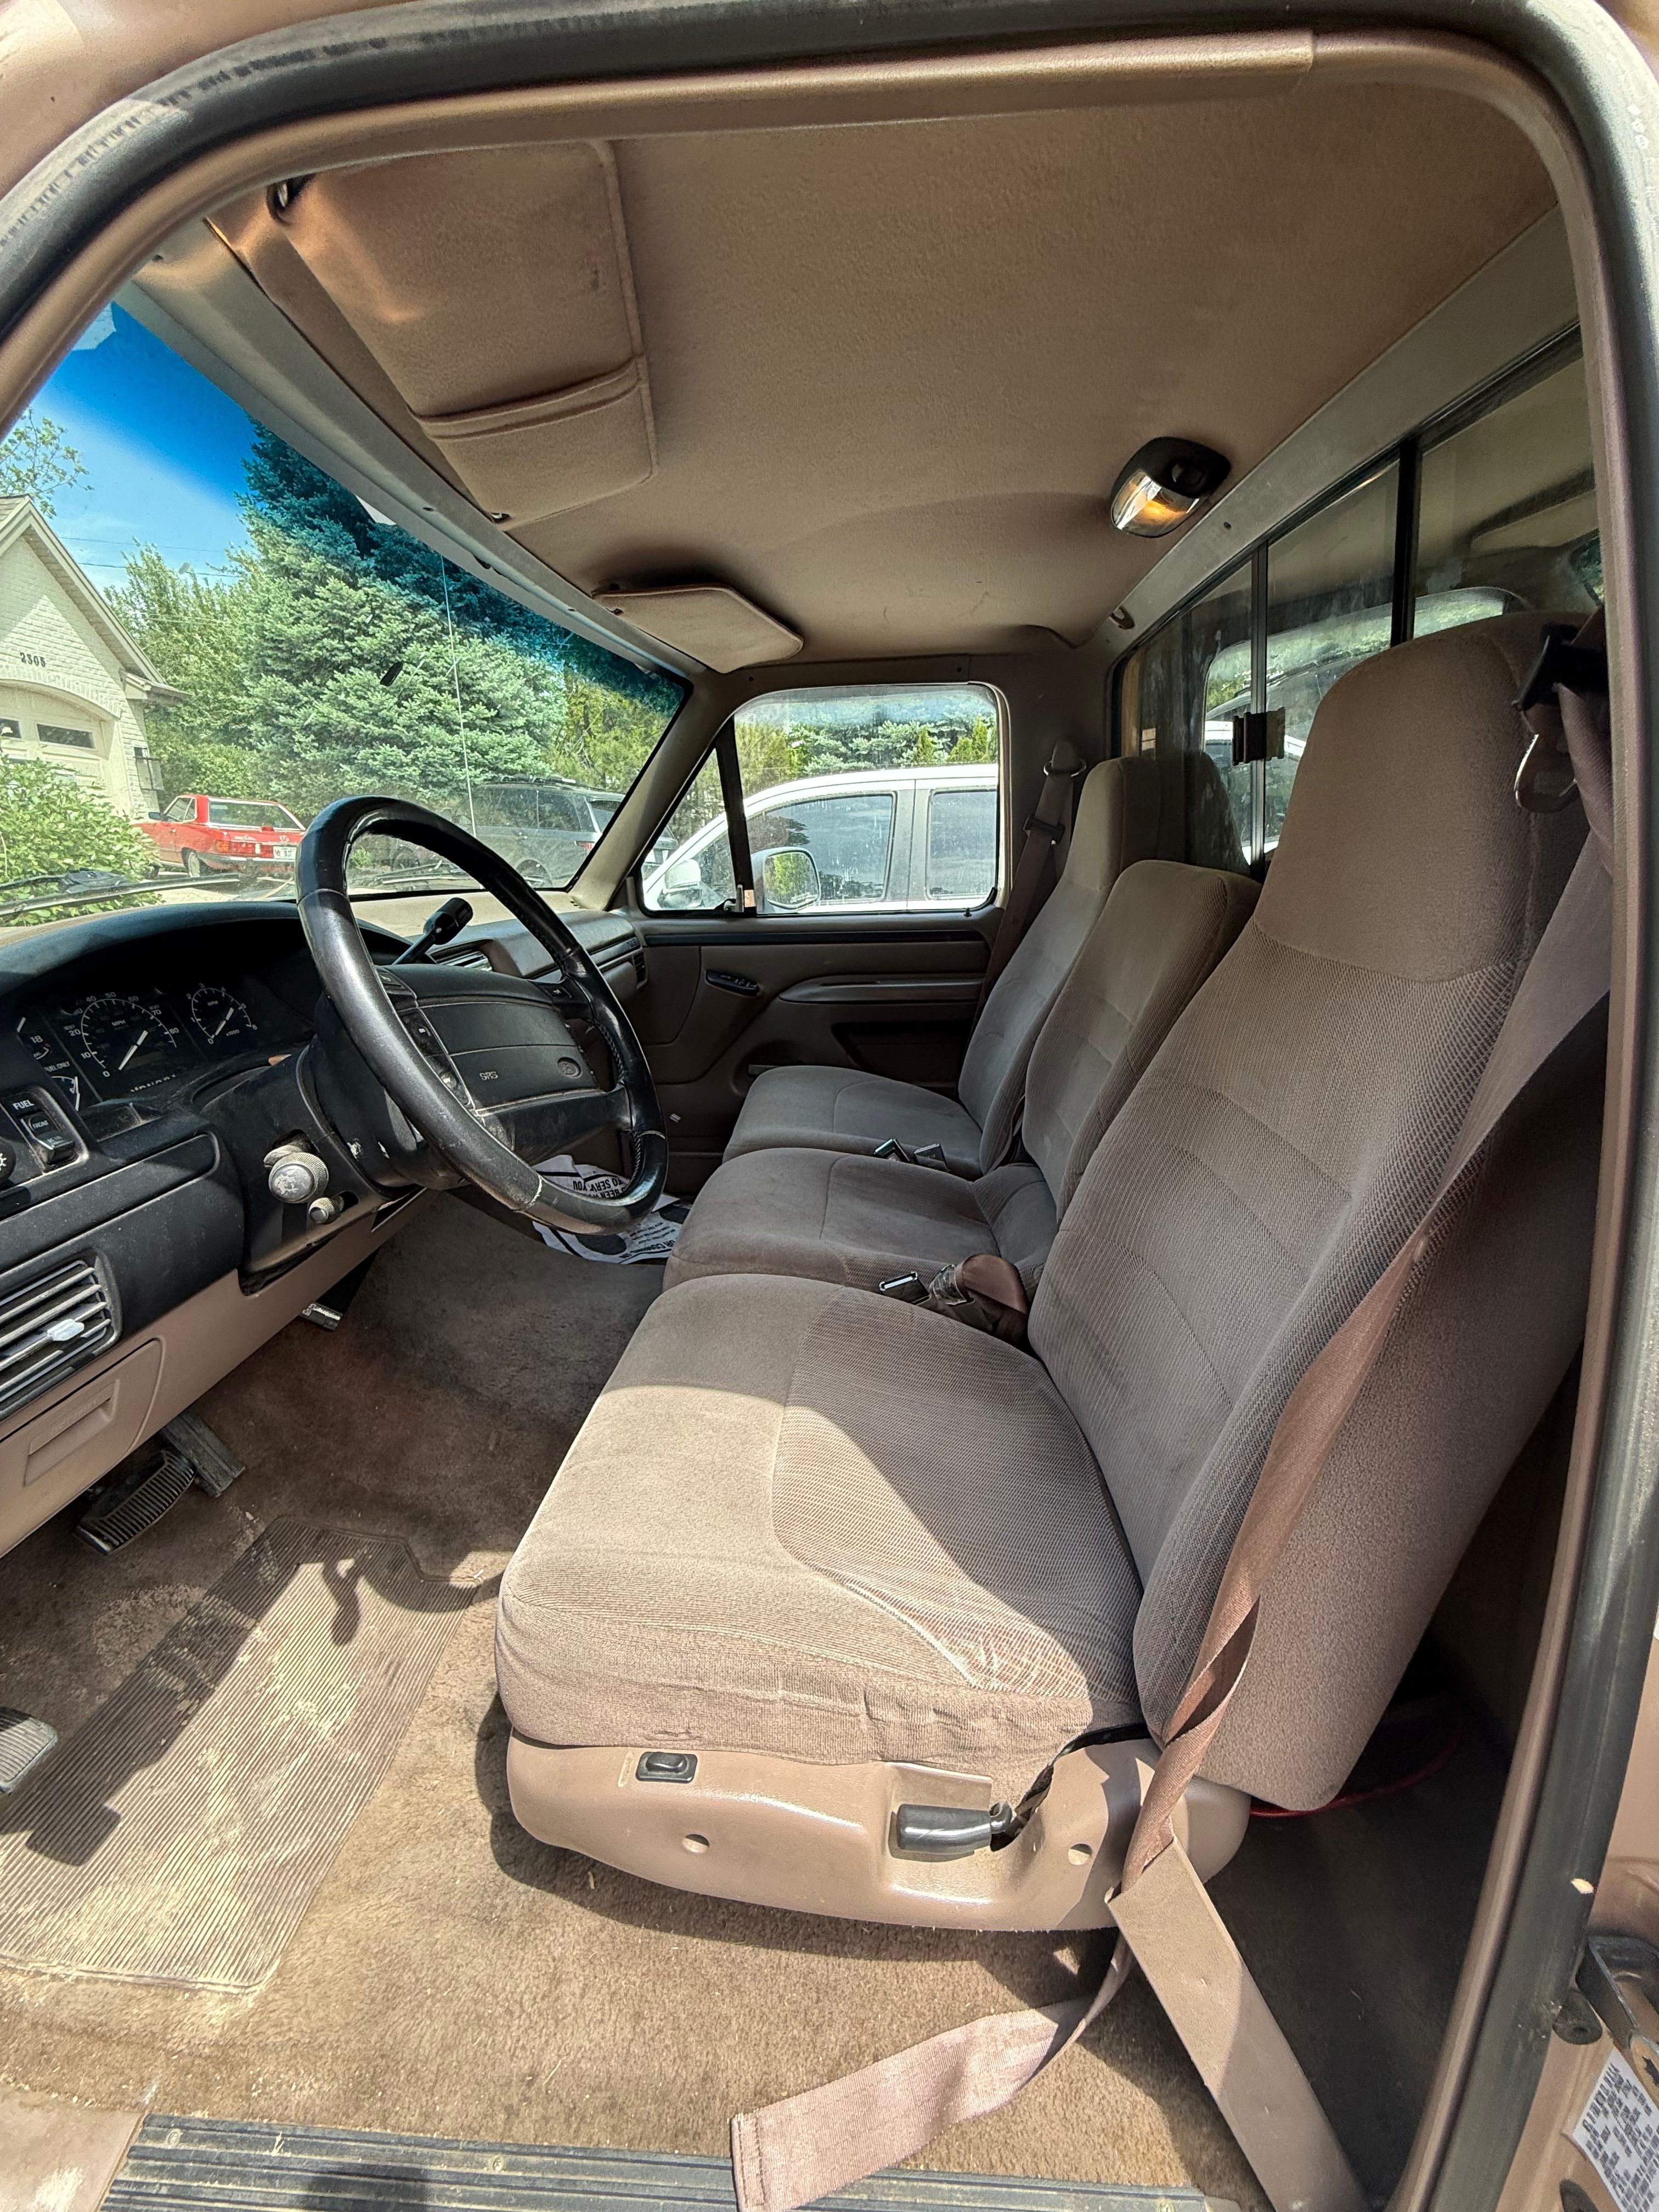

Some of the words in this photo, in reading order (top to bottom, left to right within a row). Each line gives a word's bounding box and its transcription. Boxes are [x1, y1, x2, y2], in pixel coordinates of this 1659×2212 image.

[30, 1035, 43, 1043] 18
[479, 1071, 499, 1081] SRS
[12, 1099, 35, 1110] FUEL
[573, 1181, 588, 1191] YOU
